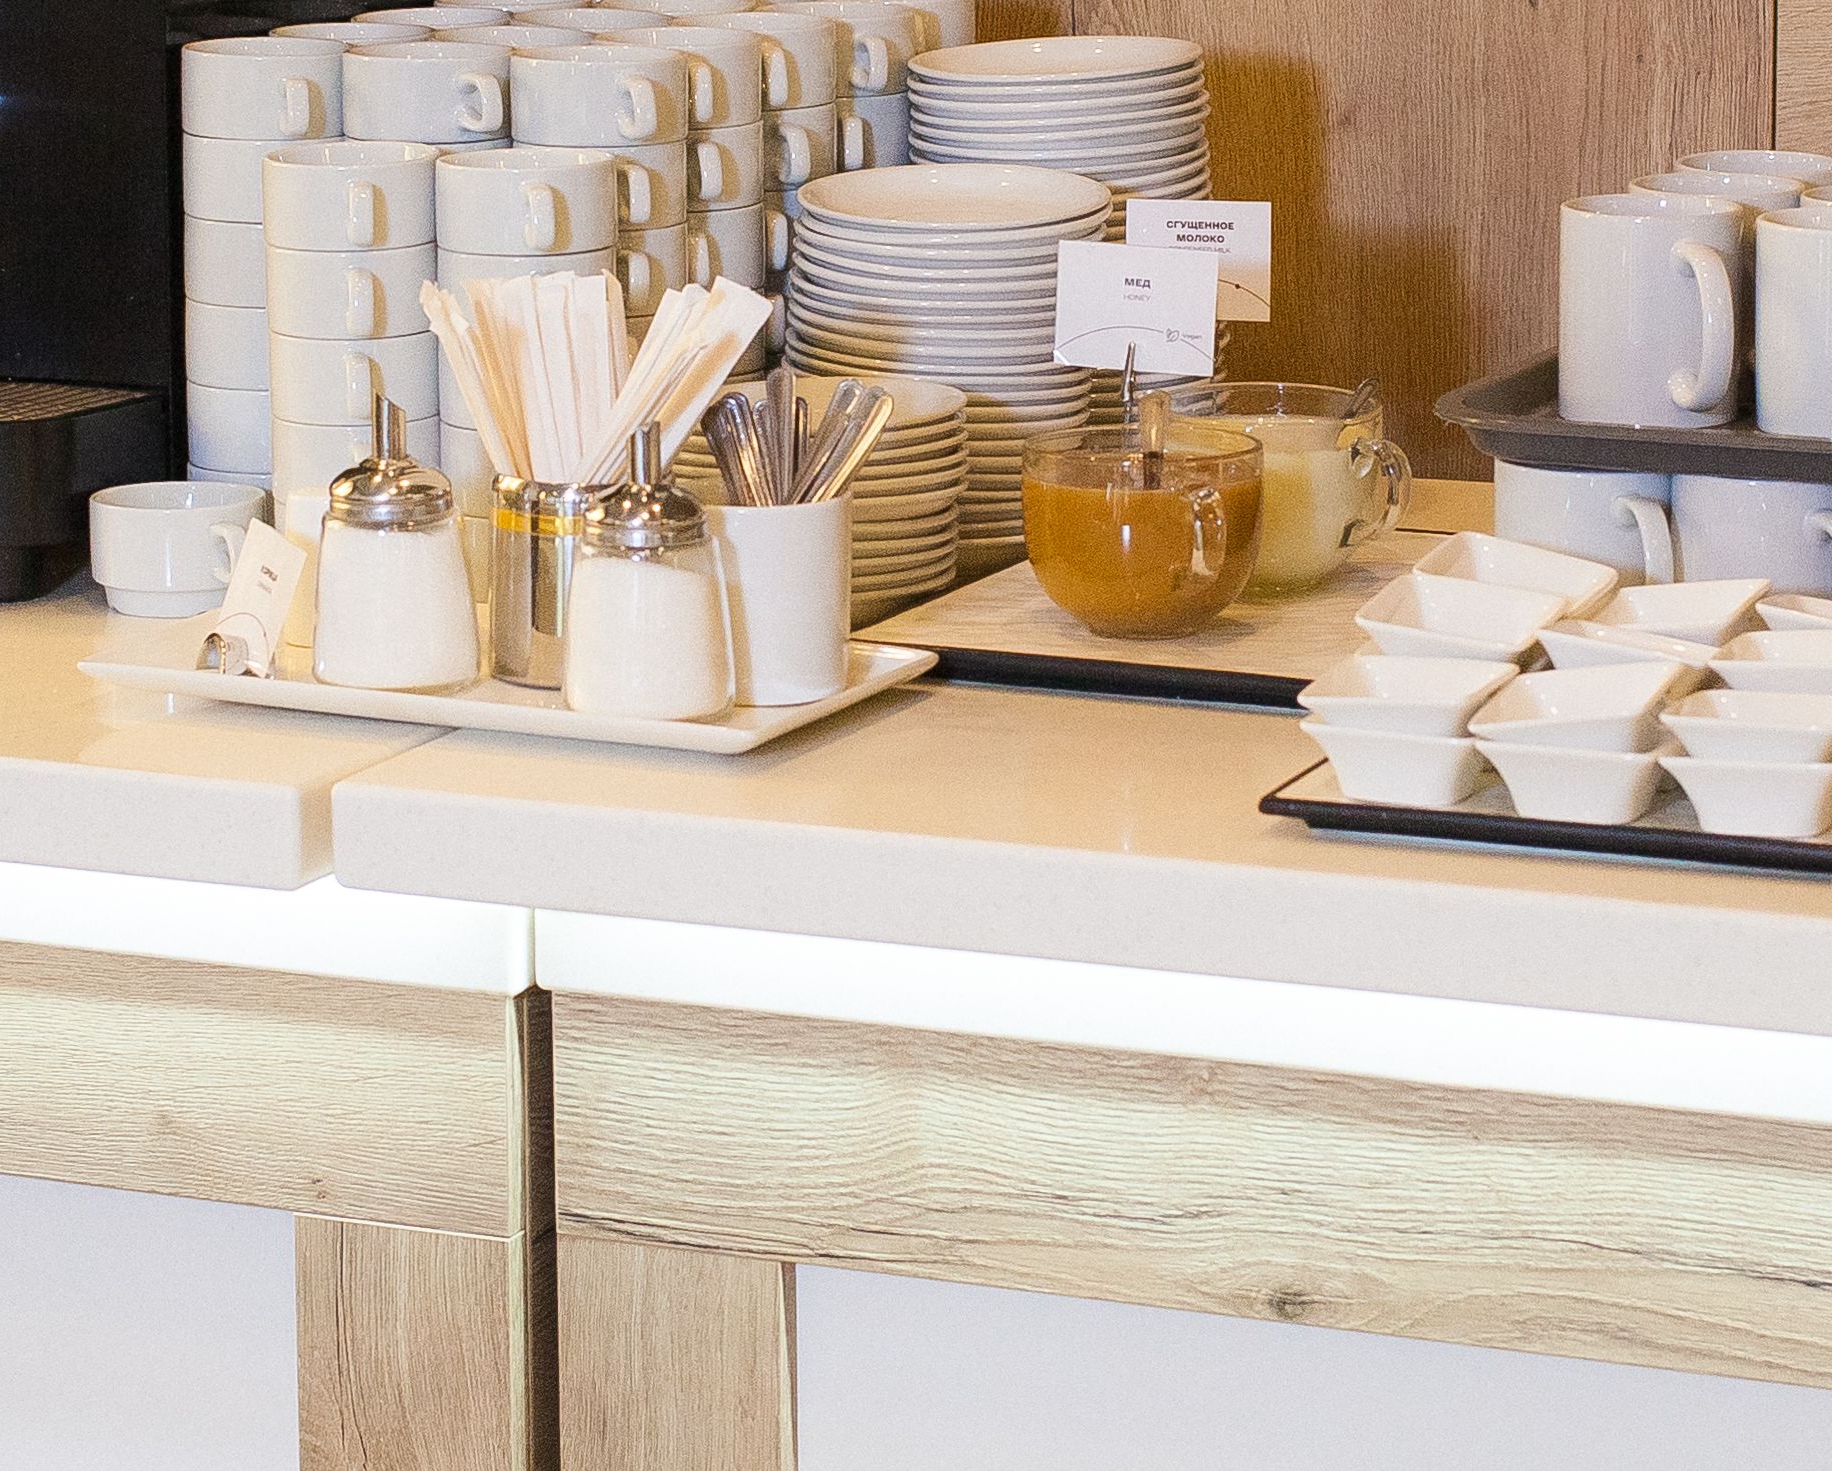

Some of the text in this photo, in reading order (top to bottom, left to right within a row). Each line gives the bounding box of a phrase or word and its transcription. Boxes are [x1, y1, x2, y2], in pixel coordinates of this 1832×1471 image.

[1166, 220, 1235, 230] СГУЩЕННОЕ
[1176, 234, 1225, 243] МОЛОКО
[1124, 278, 1151, 289] МЕД
[1123, 294, 1151, 302] HONEY
